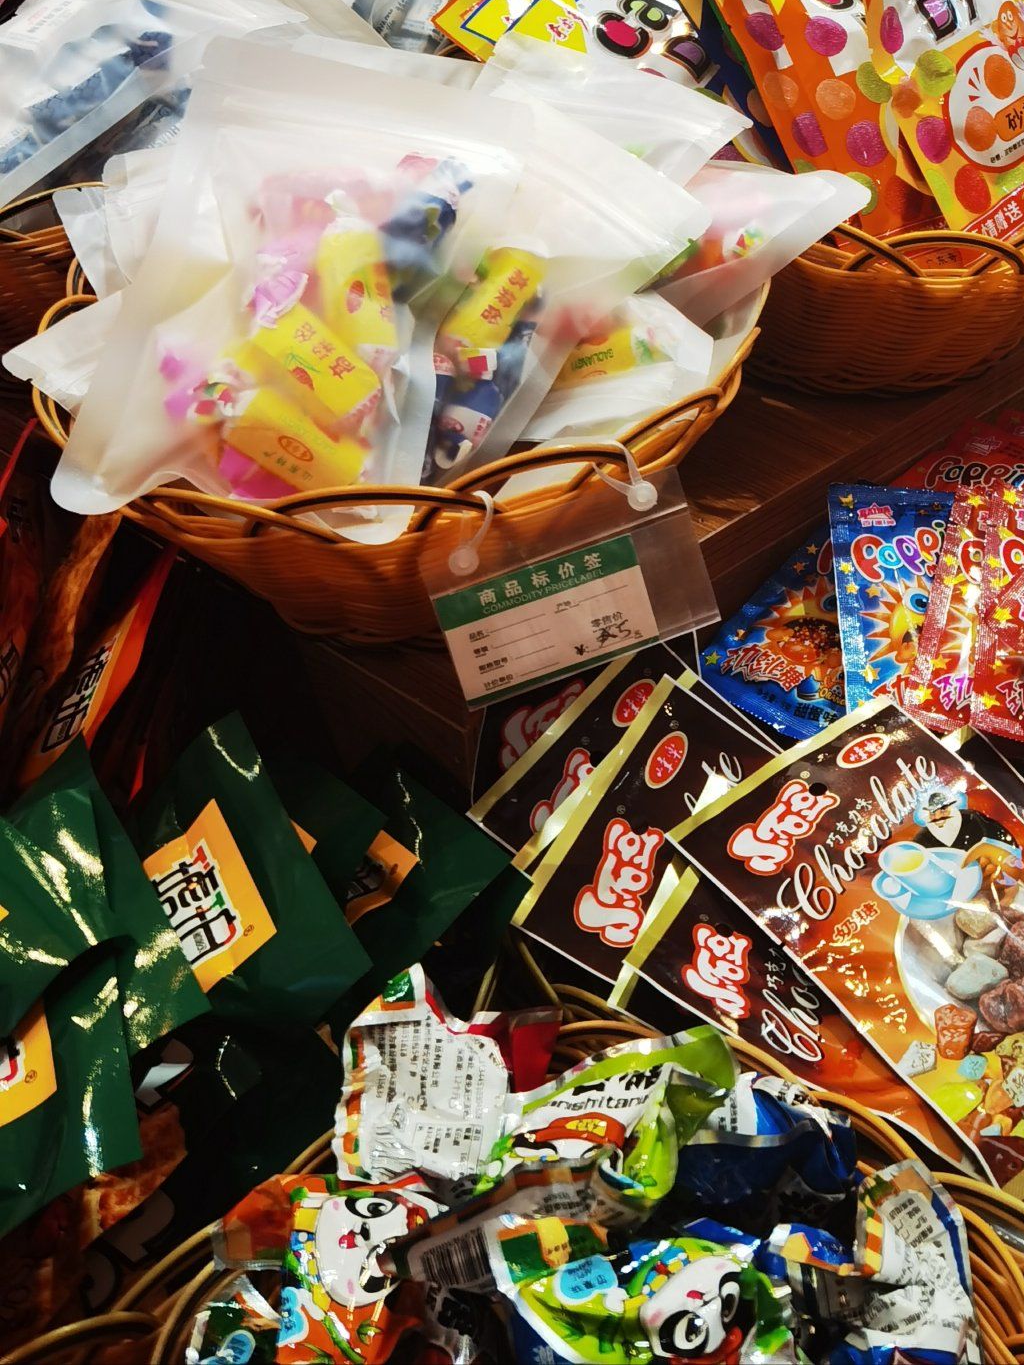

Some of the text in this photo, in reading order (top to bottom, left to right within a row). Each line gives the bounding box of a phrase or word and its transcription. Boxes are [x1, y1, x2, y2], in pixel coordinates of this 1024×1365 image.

[477, 552, 603, 605] 商品标价签
[482, 587, 545, 615] COMMODITY
[728, 779, 839, 876] 小石豆
[776, 755, 940, 921] Chocolate
[826, 796, 873, 847] 巧克力味
